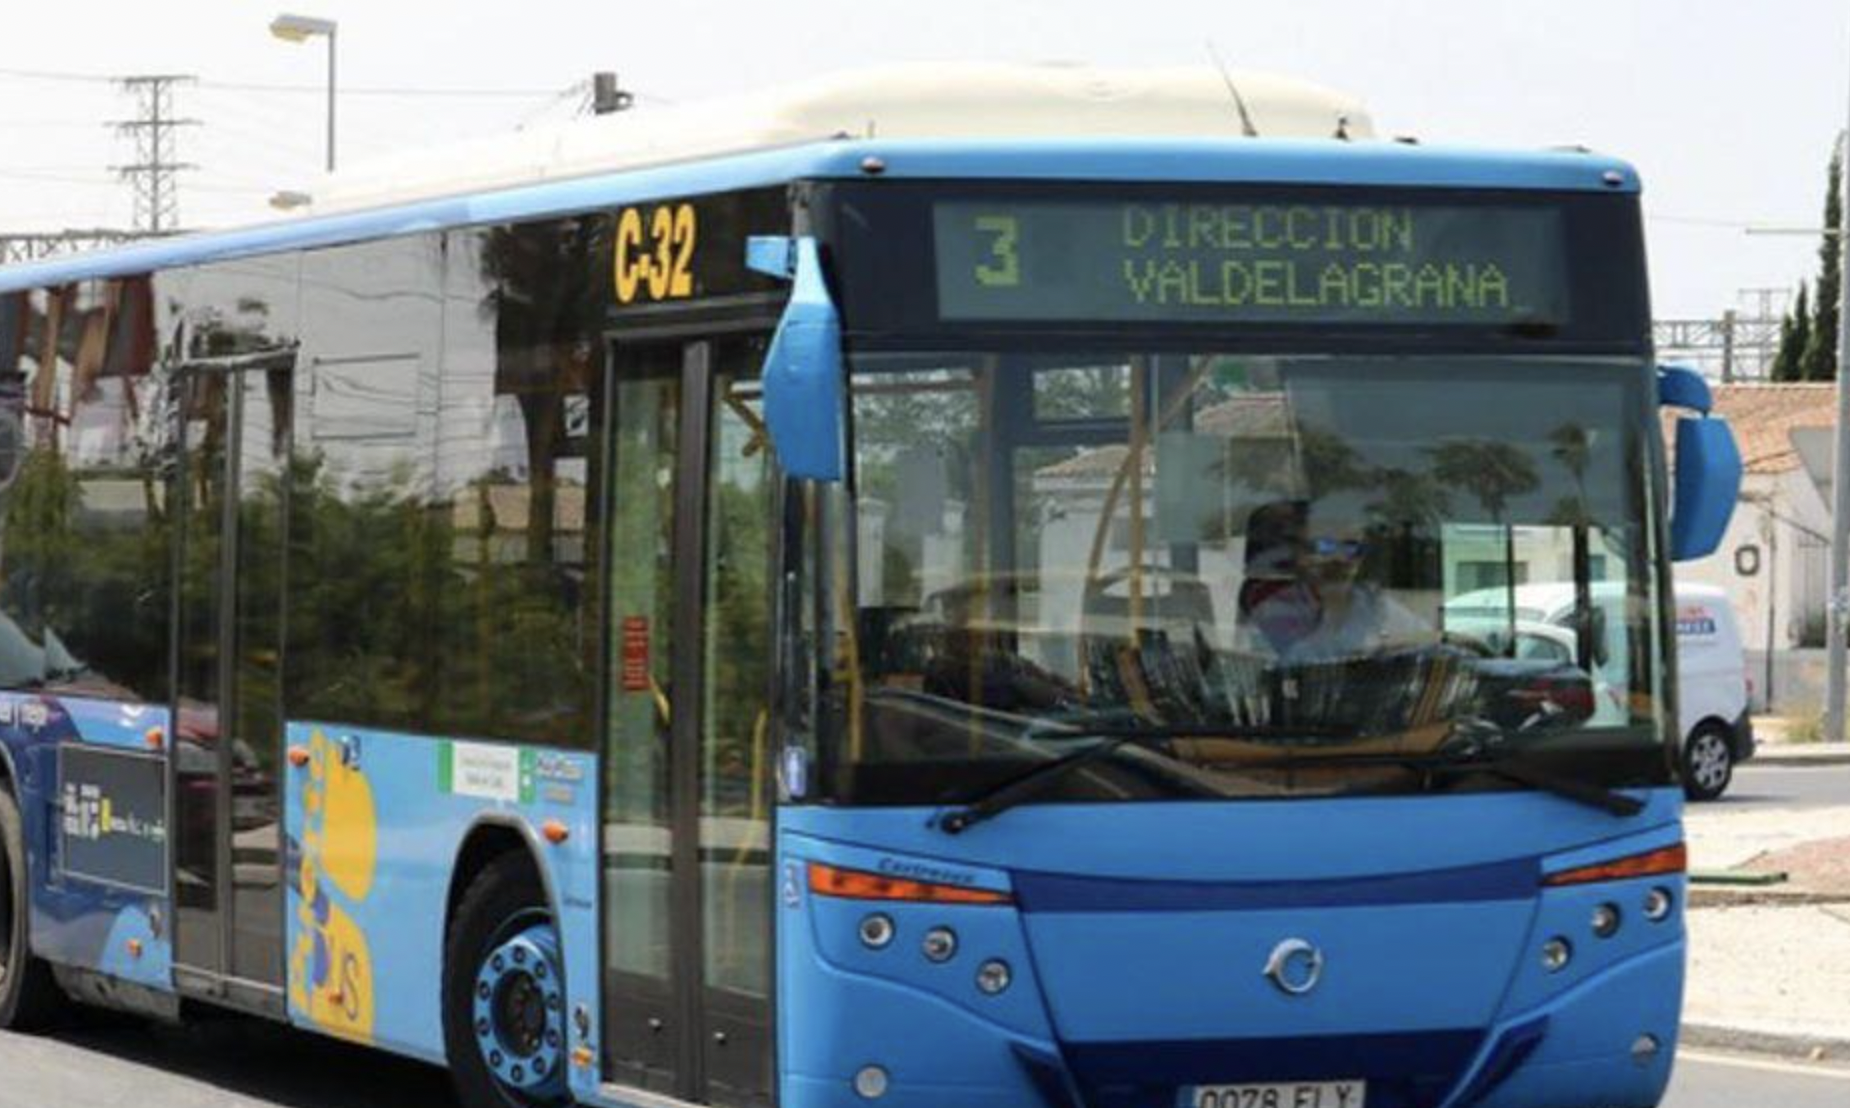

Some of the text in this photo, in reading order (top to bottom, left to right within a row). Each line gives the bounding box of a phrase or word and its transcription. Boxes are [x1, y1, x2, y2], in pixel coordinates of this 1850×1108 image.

[975, 216, 1018, 286] 3
[1124, 205, 1414, 252] DIRECCION
[615, 204, 695, 303] C-32
[1124, 259, 1509, 308] VALDELAGRANA
[1201, 1087, 1281, 1108] 0078
